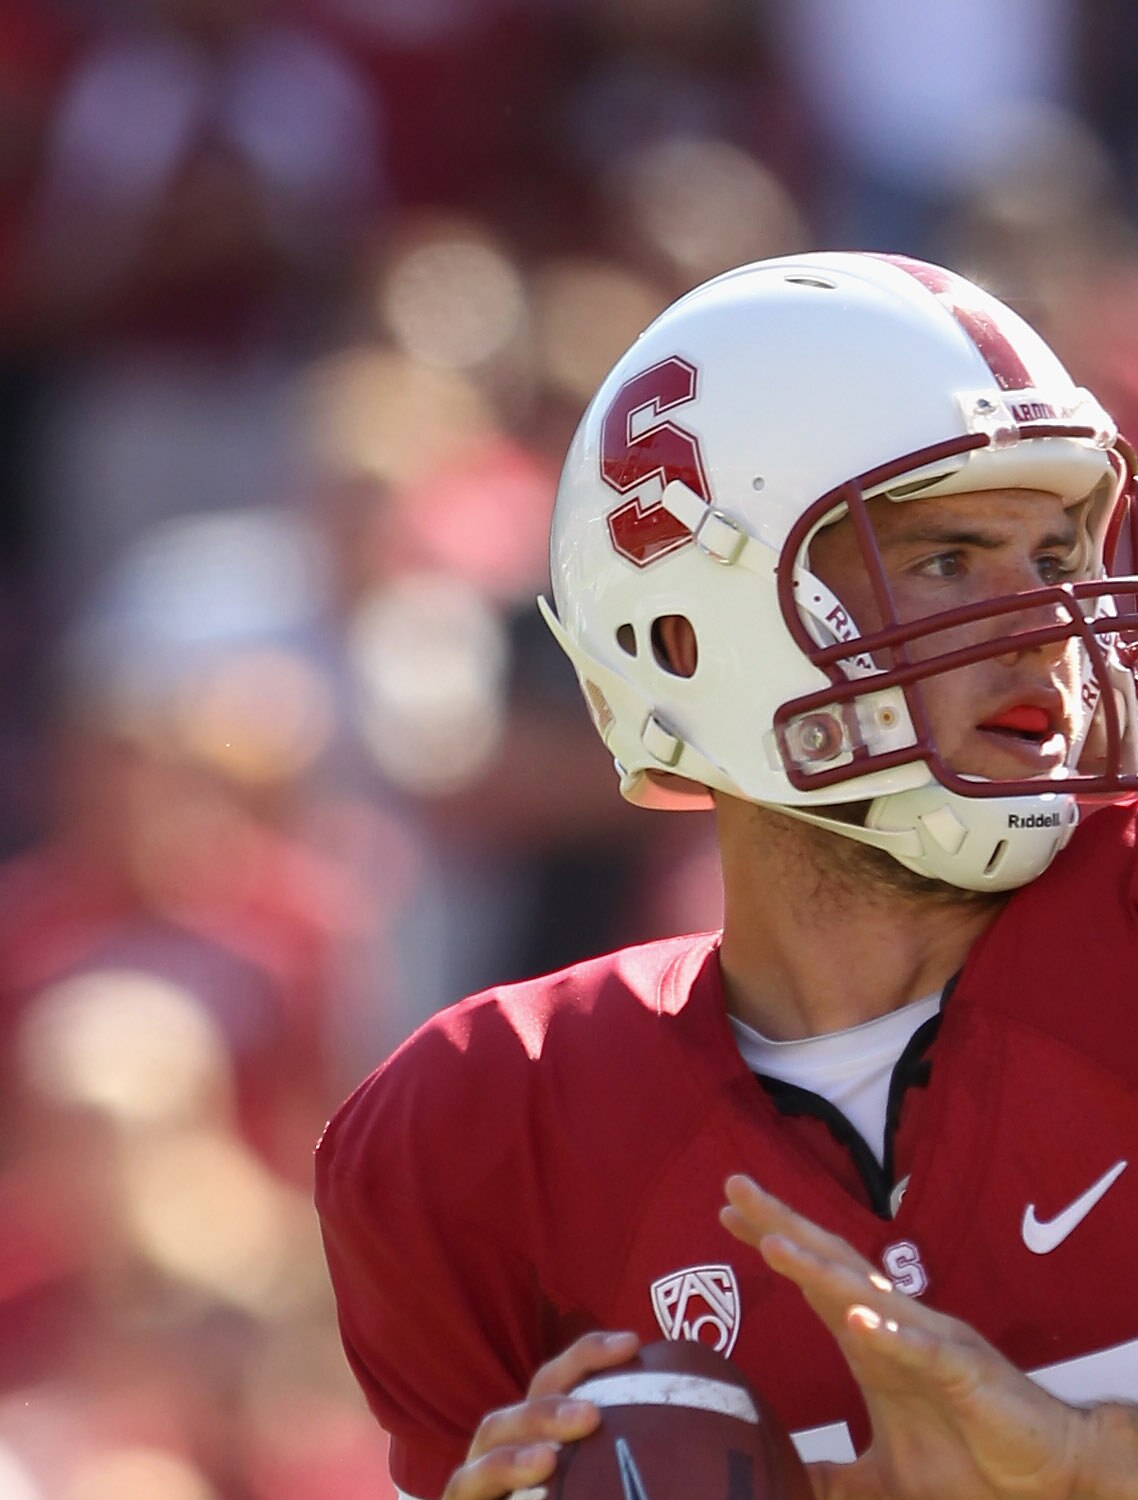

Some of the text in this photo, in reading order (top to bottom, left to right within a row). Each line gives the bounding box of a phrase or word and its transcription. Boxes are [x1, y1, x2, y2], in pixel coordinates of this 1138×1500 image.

[600, 355, 713, 568] S
[1008, 812, 1061, 828] Riddell
[883, 1242, 928, 1298] S
[656, 1270, 735, 1341] PAC
